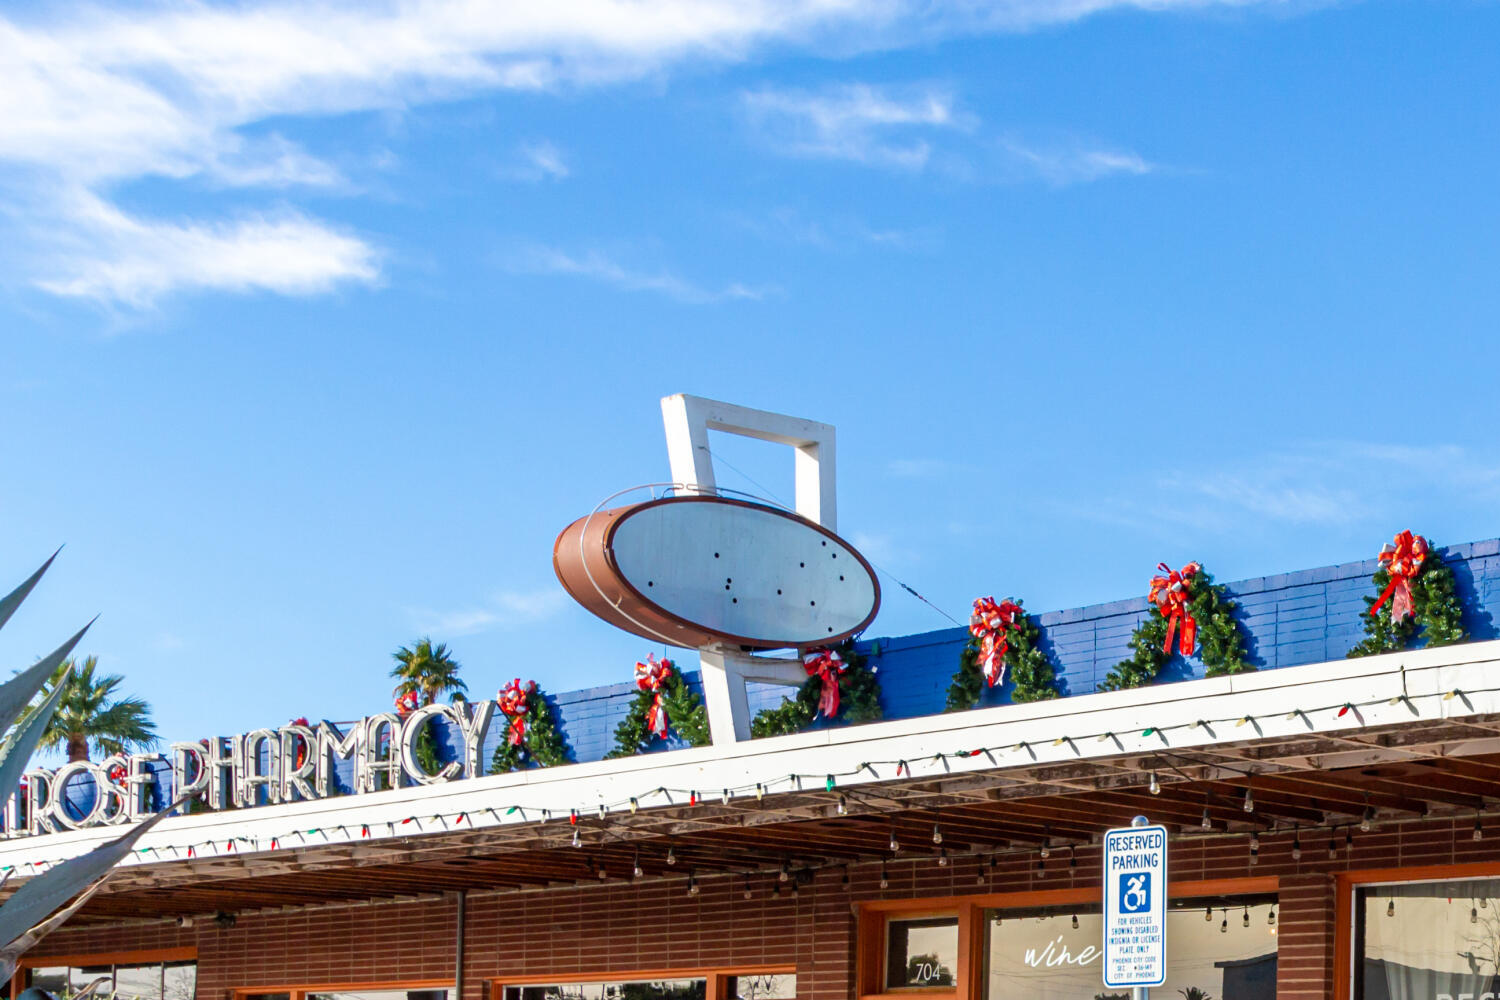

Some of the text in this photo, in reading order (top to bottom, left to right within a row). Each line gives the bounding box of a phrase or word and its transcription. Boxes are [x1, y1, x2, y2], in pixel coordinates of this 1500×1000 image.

[2, 699, 497, 840] LROSE PHARMACY
[1109, 834, 1162, 852] RESERVED
[1112, 852, 1159, 870] PARKING
[1129, 916, 1153, 925] VEHICLES
[1111, 925, 1158, 935] SHOWING DISABLED
[1109, 935, 1160, 945] INSIGNIA OR LICENSE
[1024, 935, 1103, 968] wine
[1120, 945, 1149, 954] PLATE ONLY
[916, 963, 941, 981] 704
